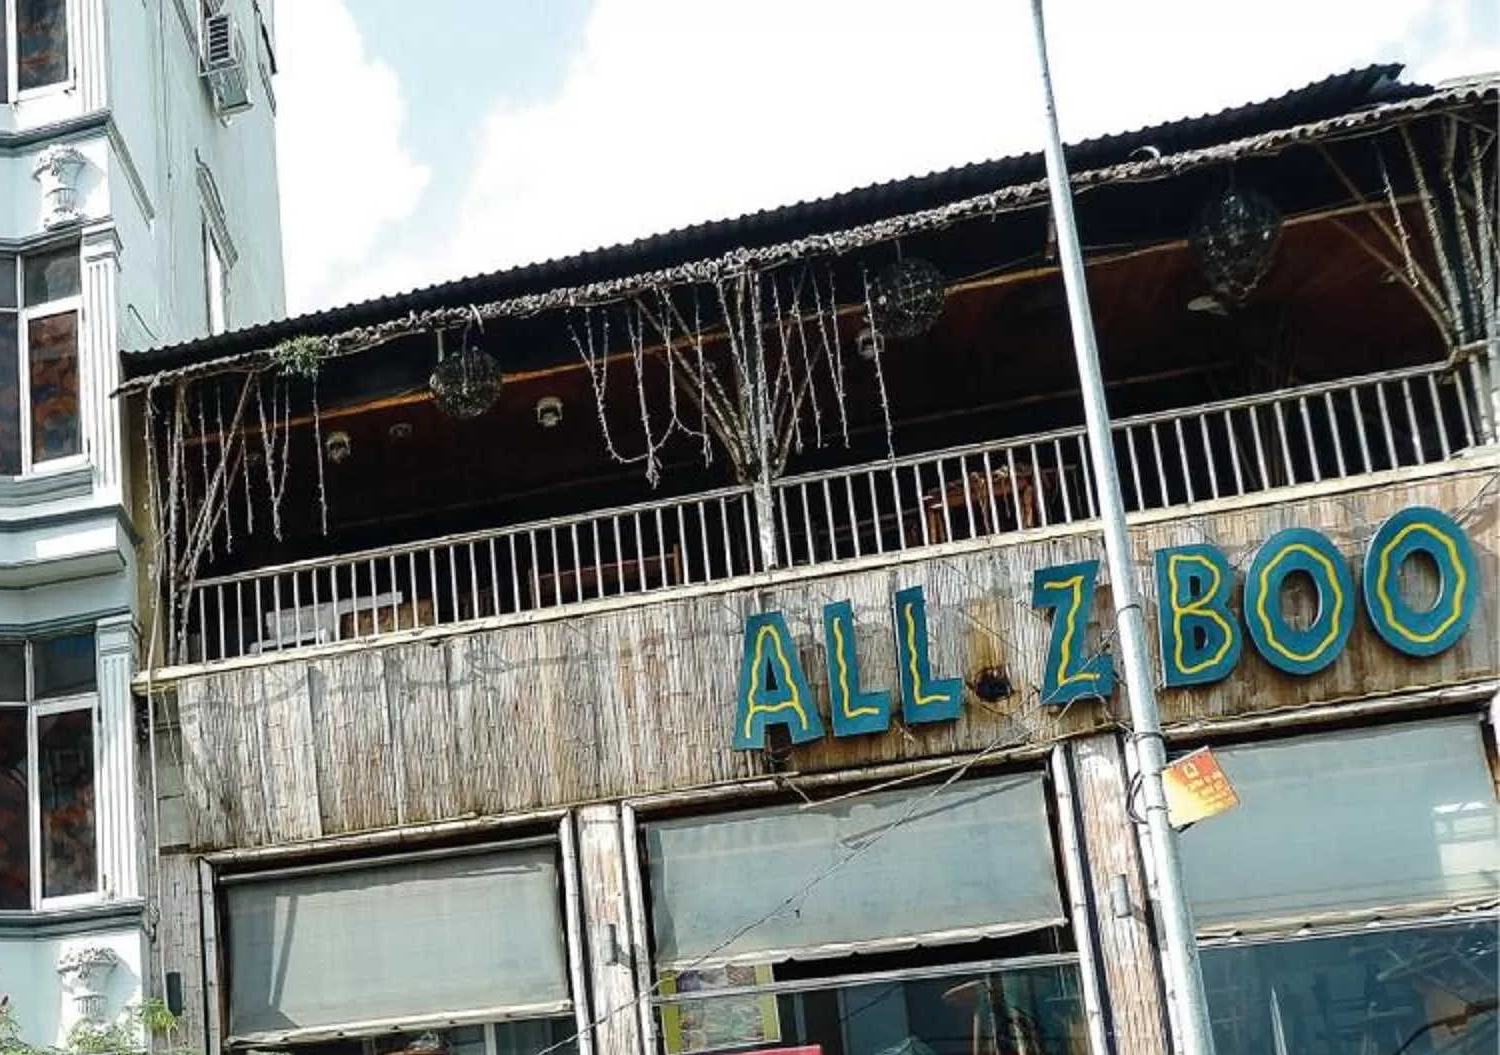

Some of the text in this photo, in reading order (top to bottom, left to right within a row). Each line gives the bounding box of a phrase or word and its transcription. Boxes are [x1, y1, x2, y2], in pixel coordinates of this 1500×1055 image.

[732, 505, 1480, 750] ALL Z BOO
